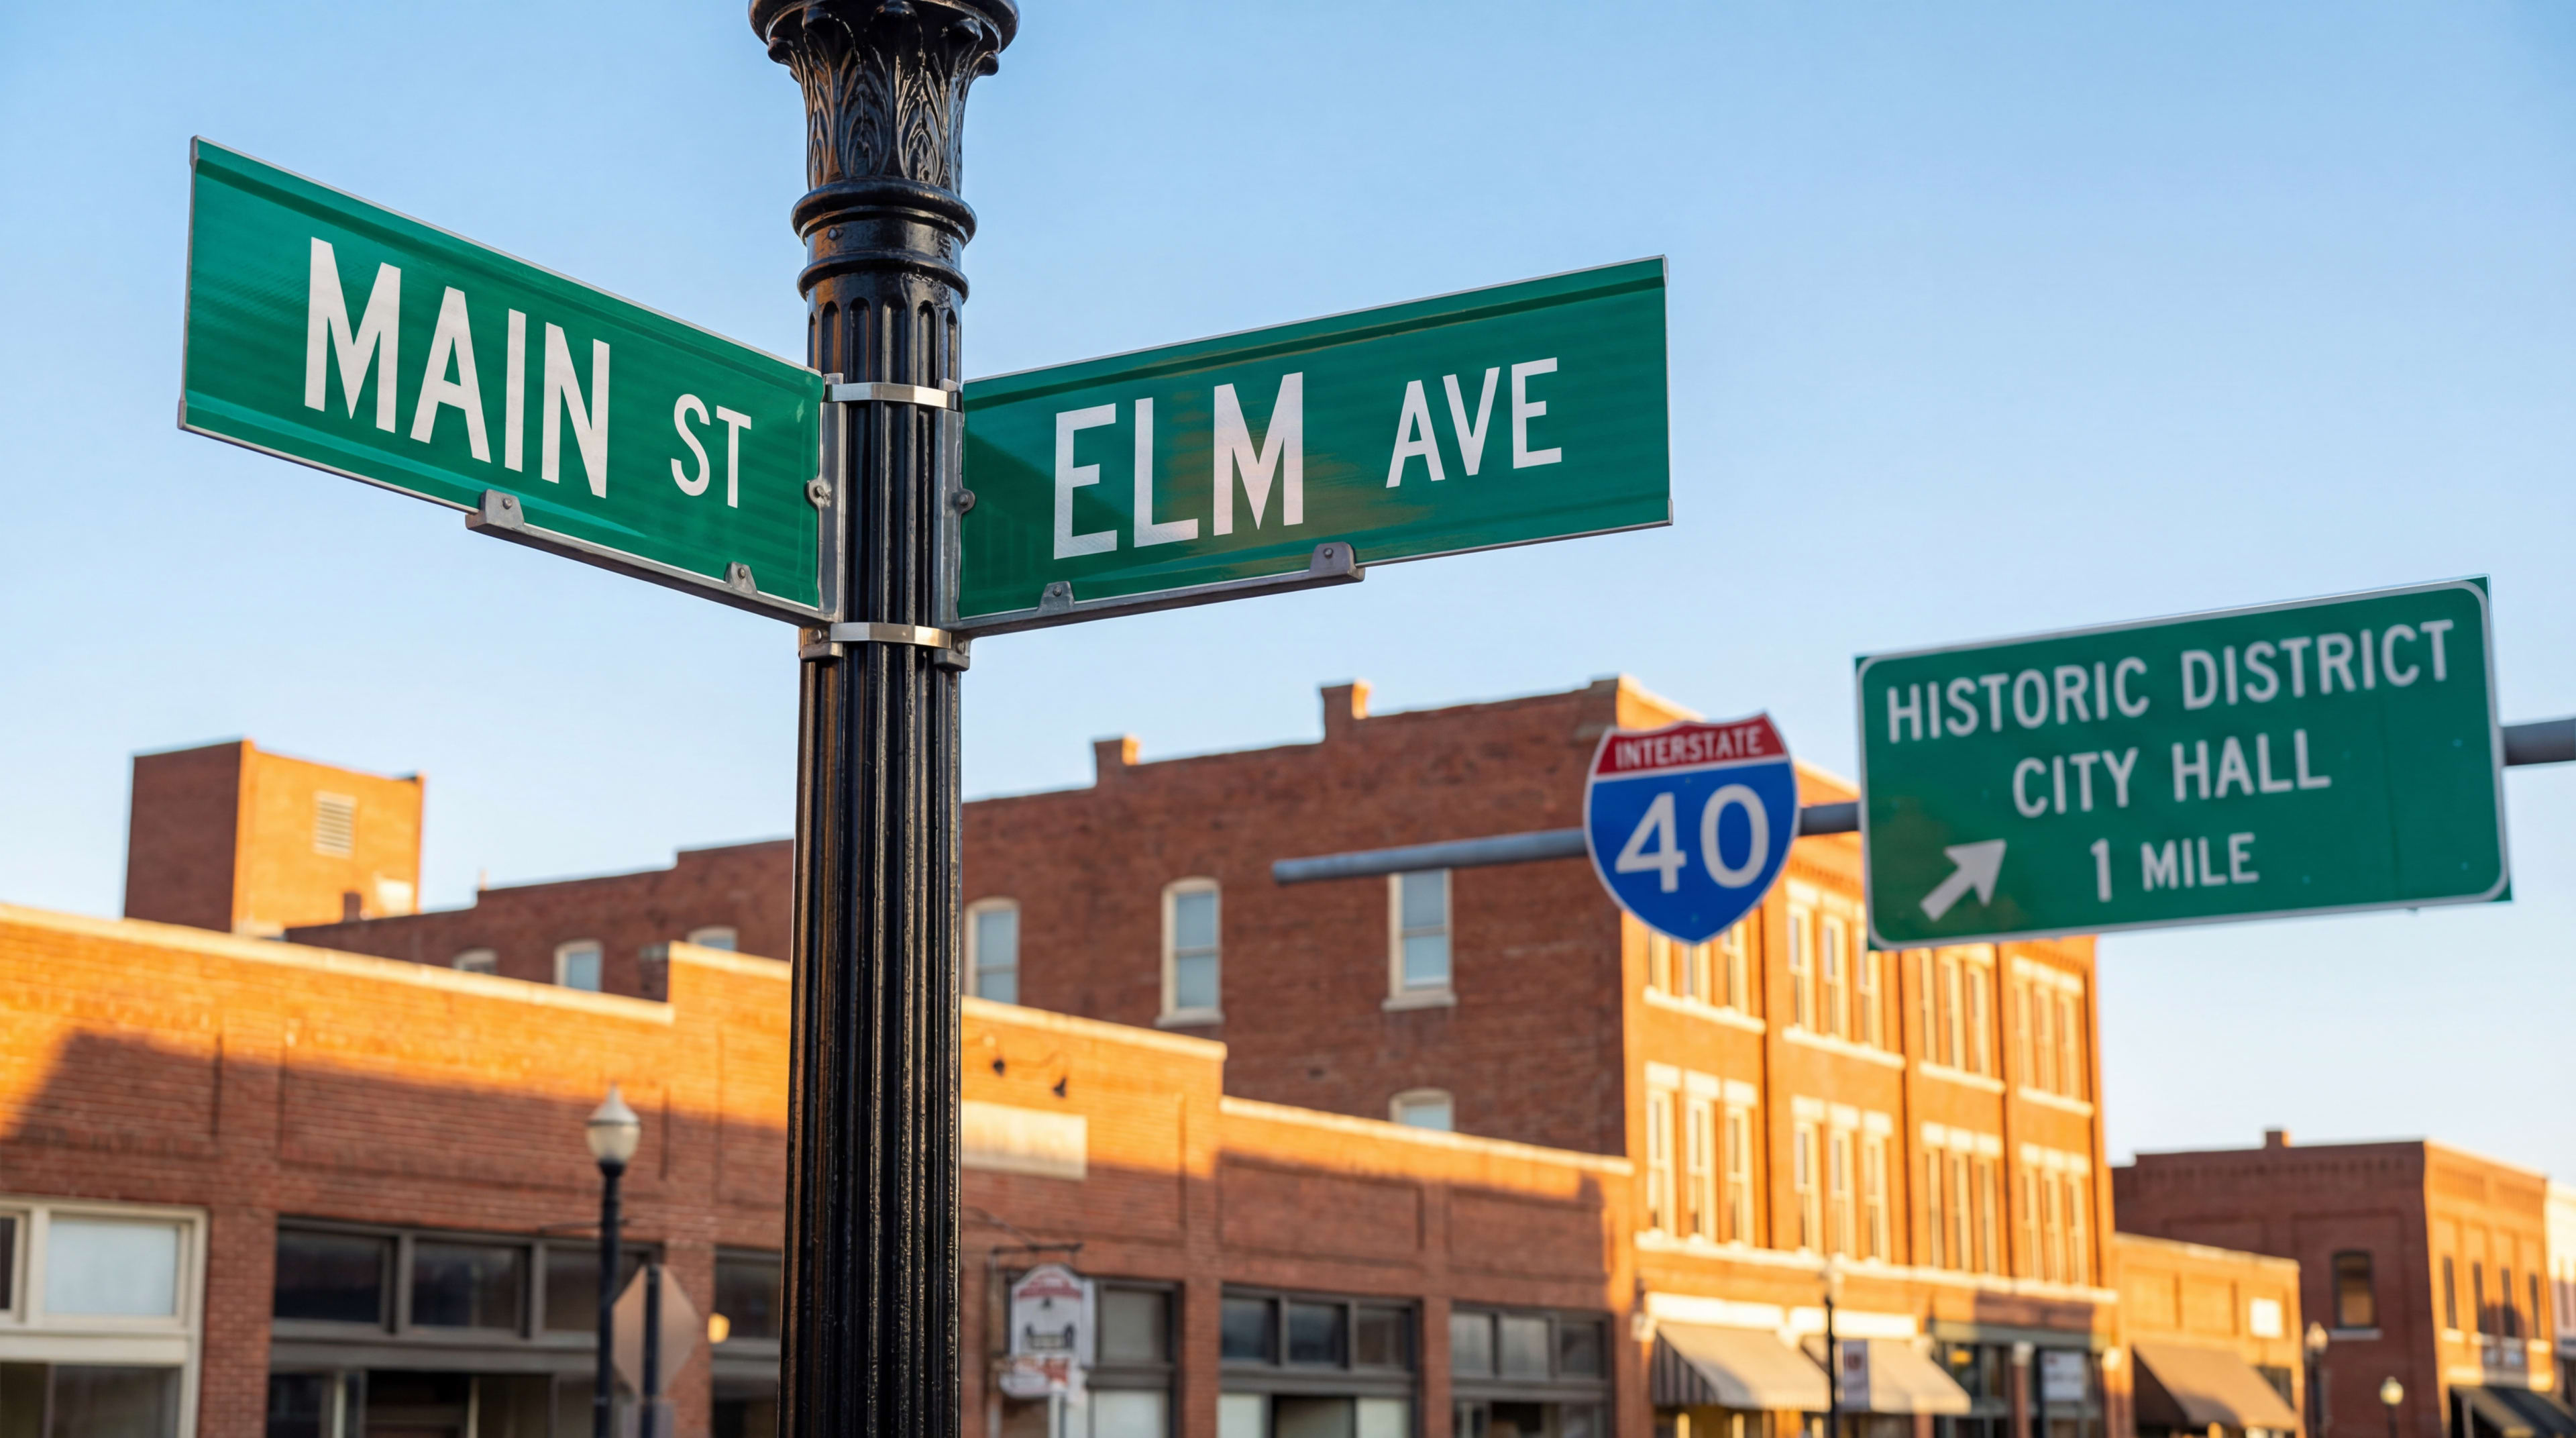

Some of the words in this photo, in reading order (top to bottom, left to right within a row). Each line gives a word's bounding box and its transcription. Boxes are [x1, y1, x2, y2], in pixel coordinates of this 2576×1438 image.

[305, 237, 610, 499] MAIN
[671, 393, 751, 508] ST
[1054, 372, 1303, 559] ELM
[1386, 358, 1562, 488] AVE
[1887, 657, 2149, 743] HISTORIC
[2180, 619, 2453, 711] DISTRICT
[1615, 725, 1764, 770] INTERSTATE
[2013, 748, 2139, 818] CITY
[2171, 729, 2331, 802] HALL
[1615, 784, 1770, 893] 40
[2090, 839, 2112, 903] 1
[2141, 832, 2259, 891] MILE
